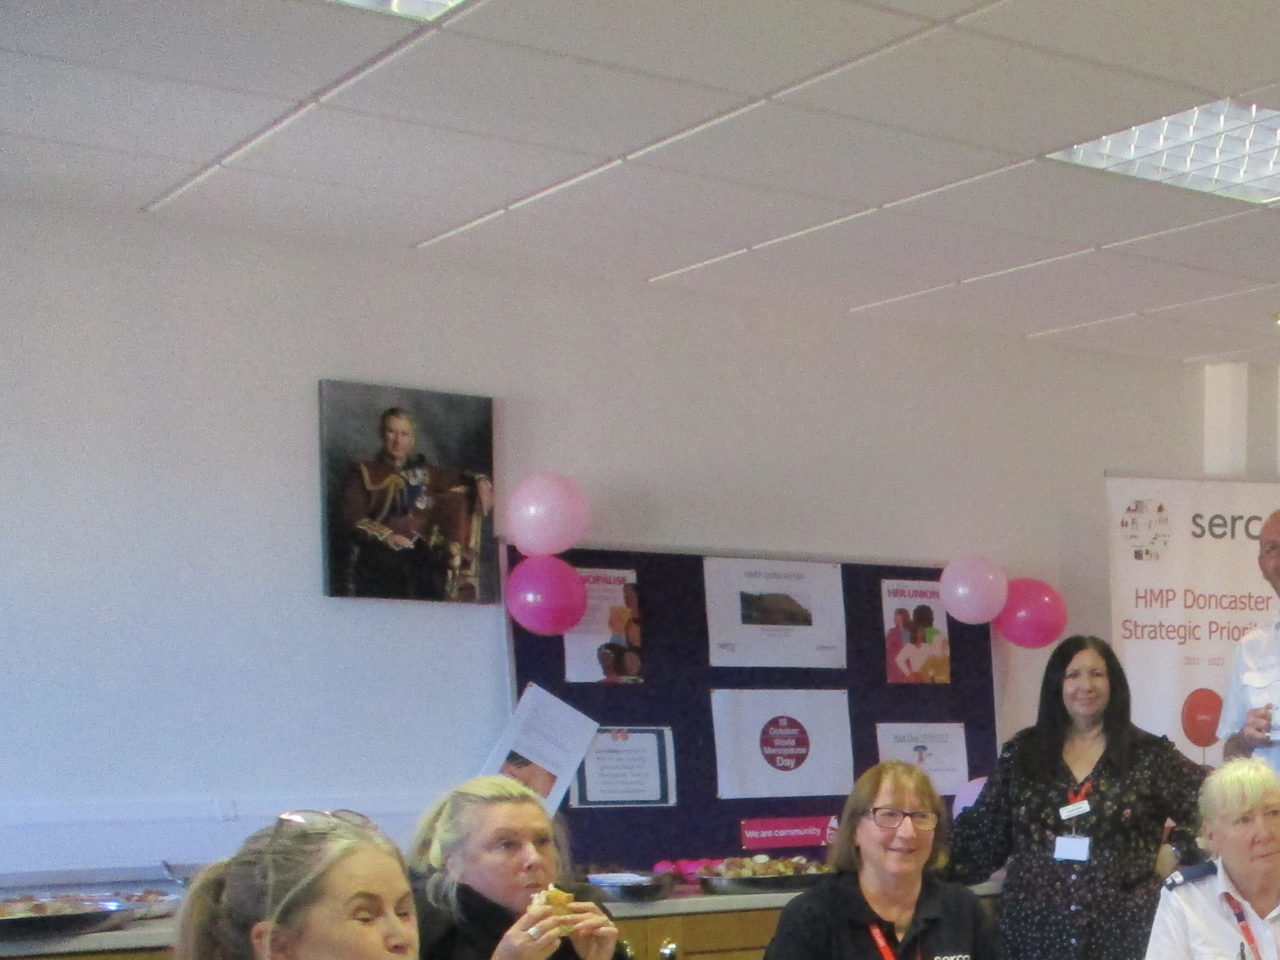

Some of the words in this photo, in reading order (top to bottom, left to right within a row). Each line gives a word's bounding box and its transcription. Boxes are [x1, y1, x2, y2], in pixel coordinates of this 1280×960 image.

[1191, 513, 1263, 540] serc
[1134, 588, 1177, 609] HMP
[1183, 589, 1273, 611] Doncaster
[1121, 619, 1201, 645] Strategic
[1208, 620, 1258, 641] Prior
[776, 756, 796, 768] Day
[774, 828, 821, 838] community
